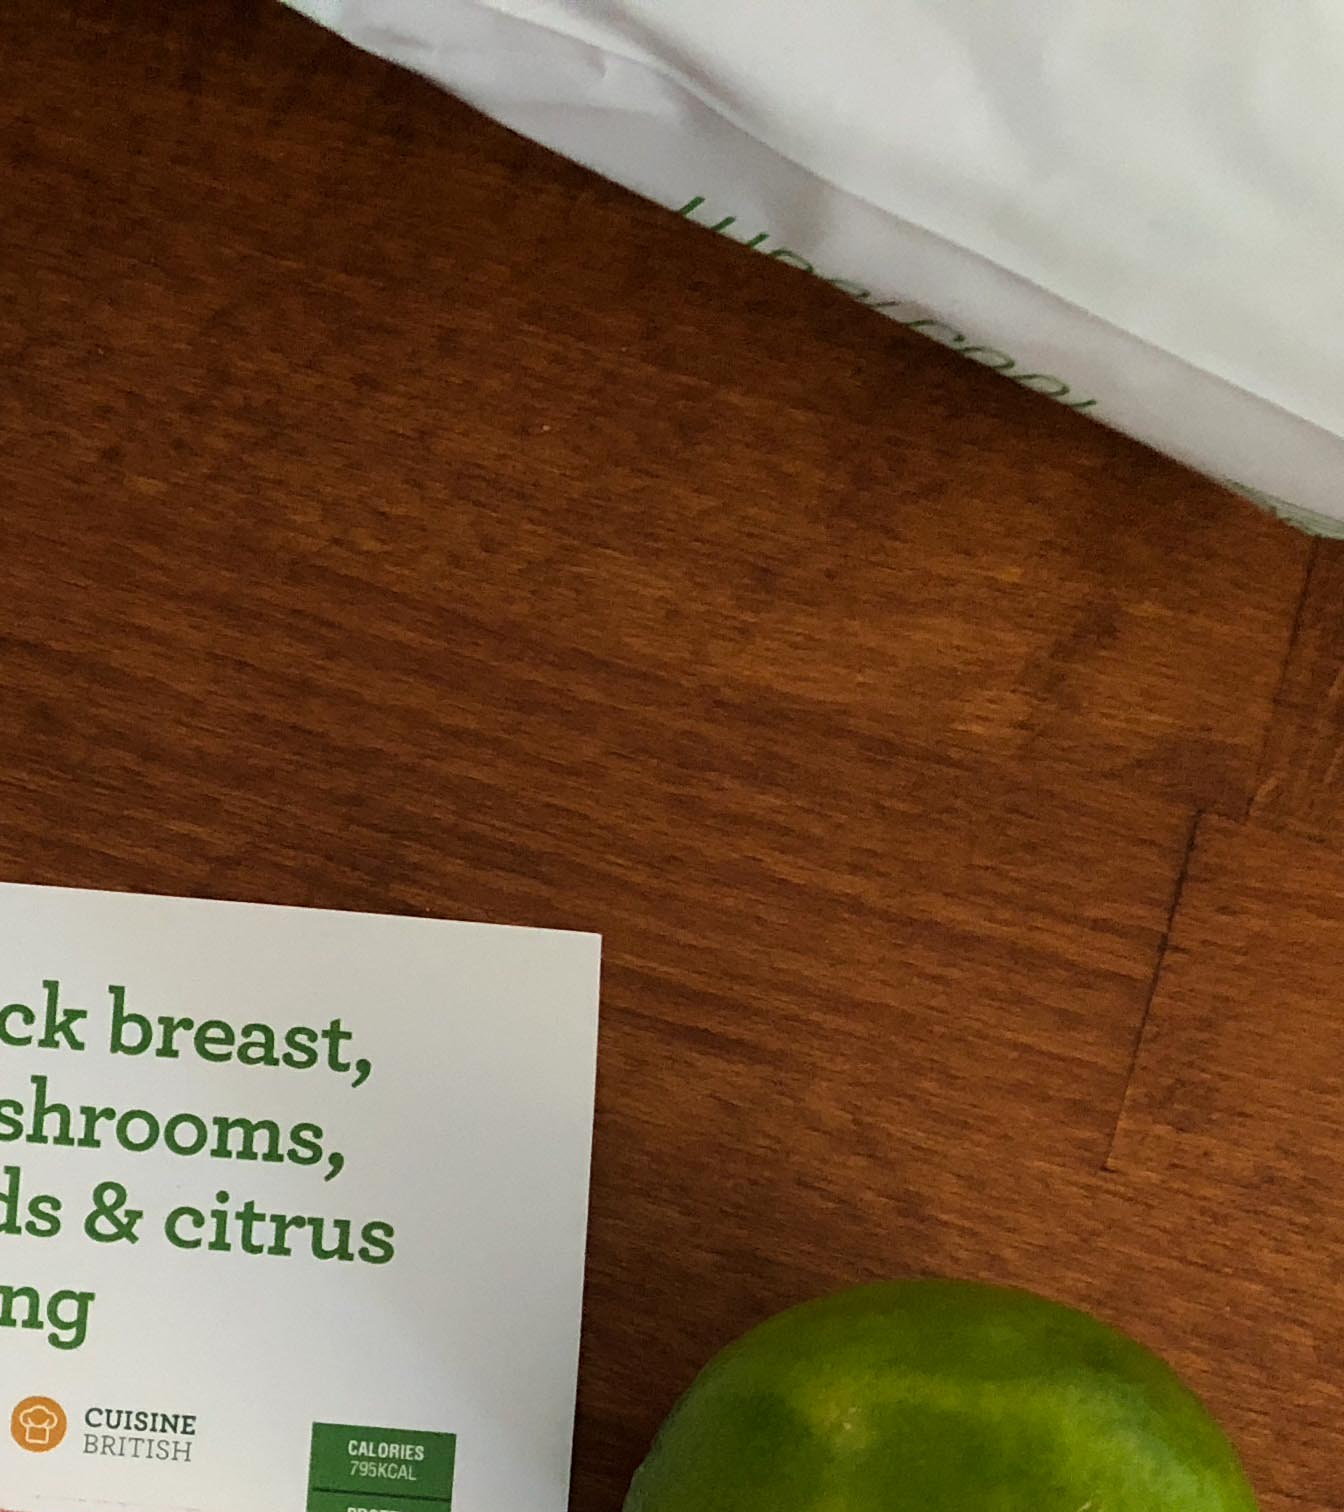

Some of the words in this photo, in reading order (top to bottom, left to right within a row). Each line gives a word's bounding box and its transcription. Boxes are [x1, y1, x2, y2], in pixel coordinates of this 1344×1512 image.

[109, 985, 371, 1088] breast,
[85, 1182, 143, 1244] &
[165, 1191, 394, 1264] citrus
[84, 1407, 197, 1436] CUISINE
[83, 1433, 192, 1462] BRITISH
[348, 1439, 425, 1461] CALORIES
[350, 1460, 417, 1481] 795KCAL
